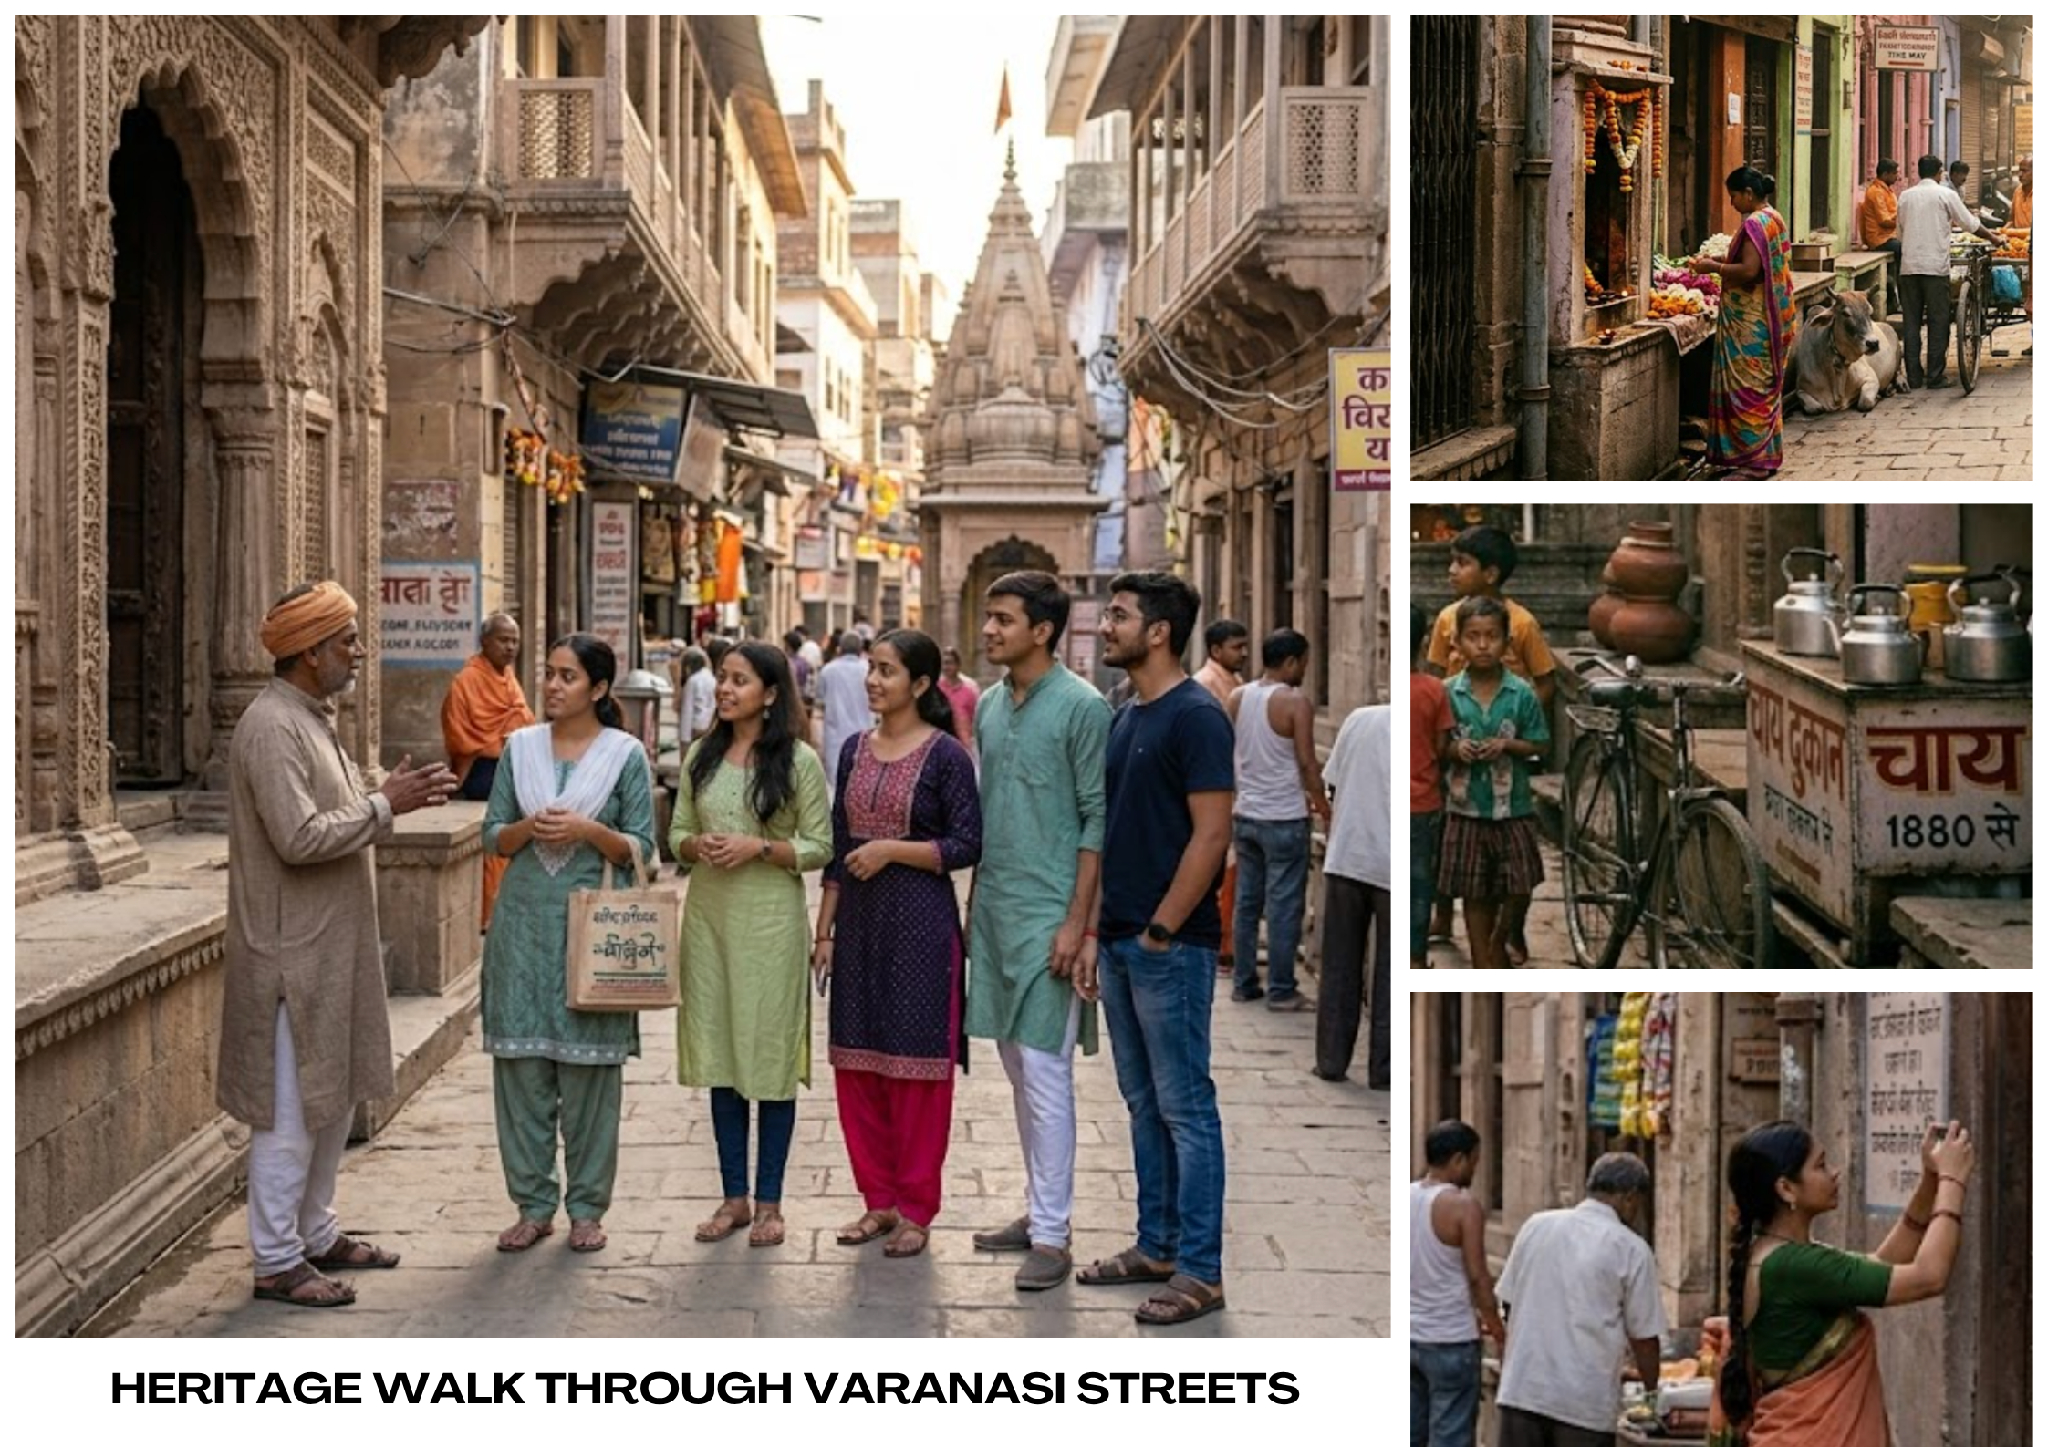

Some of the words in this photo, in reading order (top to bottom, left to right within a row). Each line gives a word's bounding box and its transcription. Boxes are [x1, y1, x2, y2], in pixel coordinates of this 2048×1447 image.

[1865, 725, 2027, 794] चाय
[1886, 813, 1976, 848] 1880
[1984, 801, 2021, 851] से
